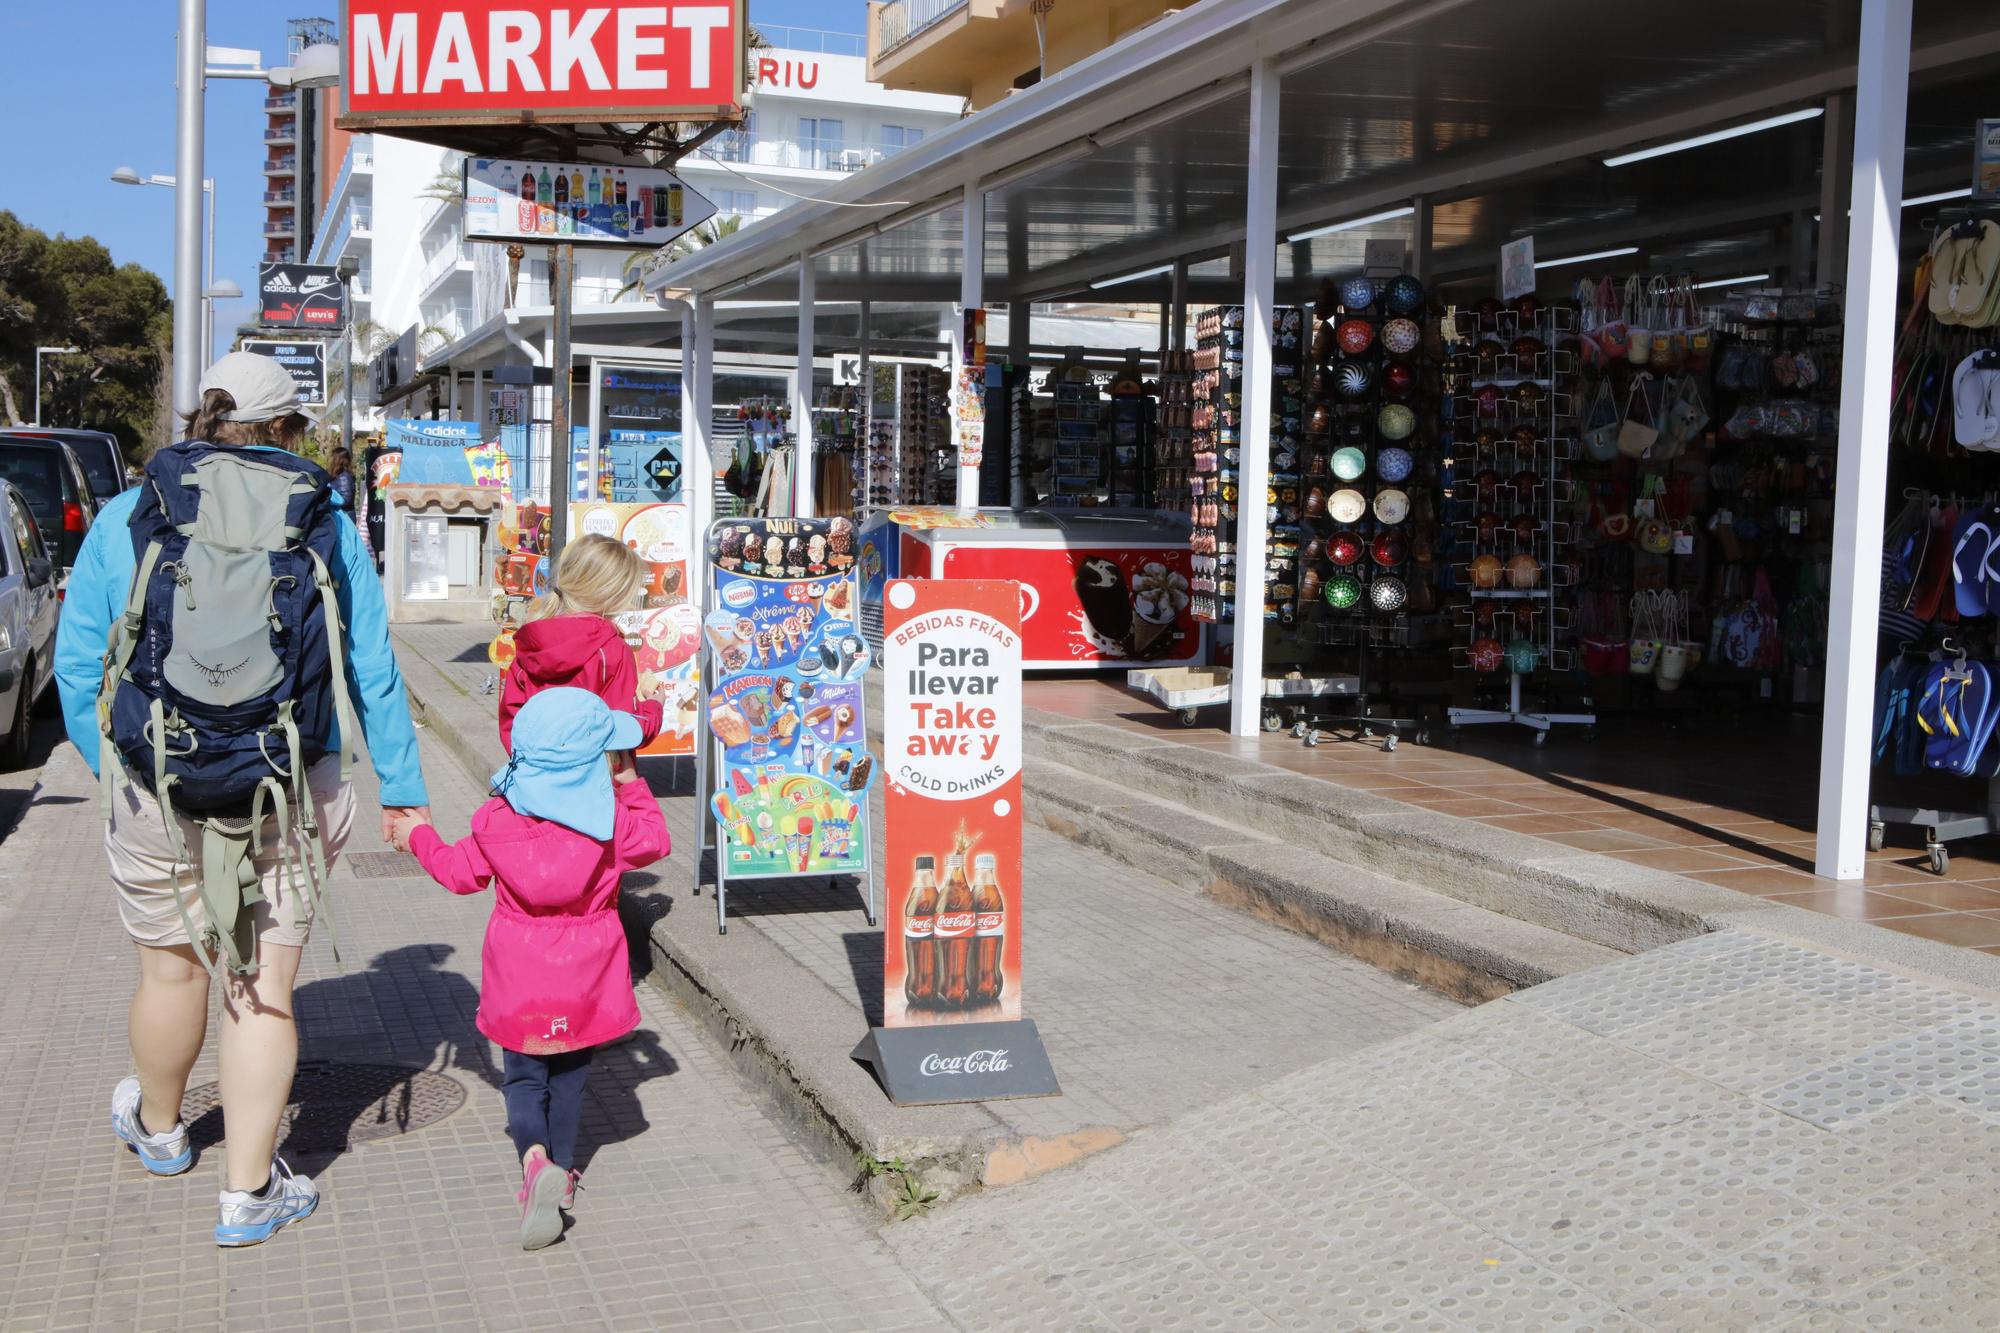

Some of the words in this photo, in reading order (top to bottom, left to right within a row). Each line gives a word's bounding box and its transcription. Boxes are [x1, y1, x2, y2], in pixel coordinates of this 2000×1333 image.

[352, 5, 730, 95] MARKET
[758, 57, 819, 90] RIU
[263, 284, 297, 294] adidas
[304, 274, 331, 286] NIKE
[400, 434, 466, 447] MALLORCA
[423, 425, 467, 437] adidas
[895, 615, 964, 646] BEBIDAS
[968, 618, 1014, 648] FRÍAS
[918, 642, 990, 667] Para
[150, 679, 160, 687] 48
[723, 675, 772, 700] MAXIBON
[820, 686, 848, 700] Milka
[908, 670, 999, 695] llevar
[910, 701, 996, 729] Take
[900, 765, 942, 792] COLD
[947, 764, 1005, 793] DRINKS
[936, 913, 973, 928] Coca-Cola
[919, 1048, 1010, 1076] Coca-Cola
